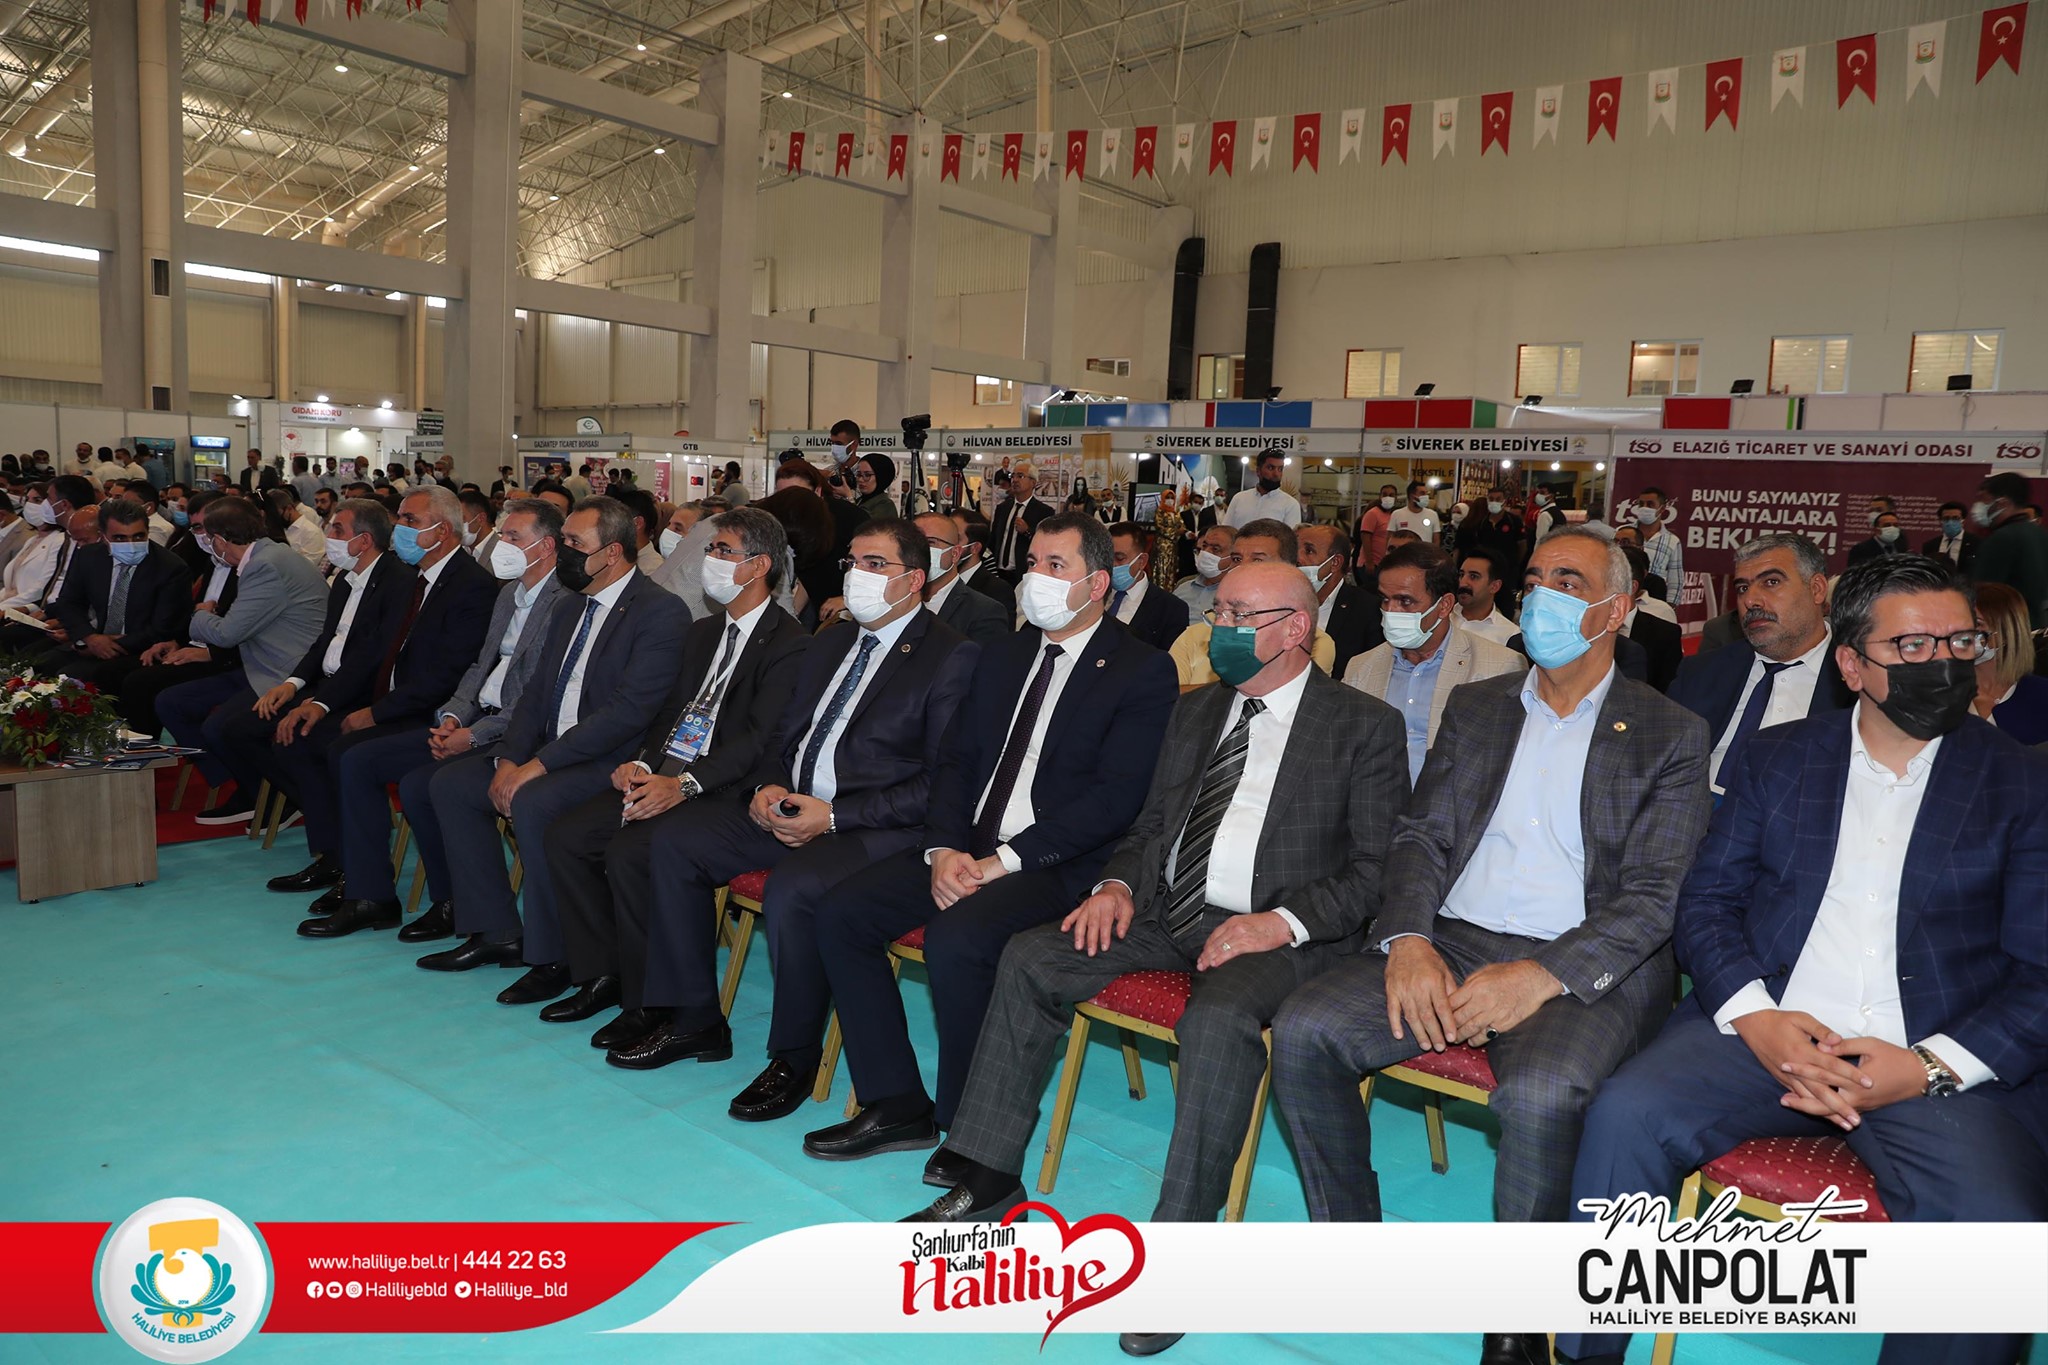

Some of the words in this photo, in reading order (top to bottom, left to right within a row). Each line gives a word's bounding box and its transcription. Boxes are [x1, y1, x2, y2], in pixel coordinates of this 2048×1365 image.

[578, 440, 600, 448] BORSASI
[683, 443, 699, 451] GTB
[806, 436, 832, 447] HİLVA
[963, 435, 1002, 447] HİLVAN
[1005, 434, 1072, 447] BELEDİYESİ
[1156, 434, 1211, 447] SİVEREK
[1215, 435, 1294, 449] BELEDİYESİ
[1396, 436, 1465, 451] SİVEREK
[1469, 436, 1569, 452] BELEDİYESİ
[1629, 440, 1662, 454] tso
[1673, 440, 1730, 453] ELAZIĞ
[1736, 440, 1807, 455] TİCARET
[1813, 444, 1836, 456] VE
[1841, 442, 1908, 456] SANAYİ
[1914, 444, 1973, 457] ODASI
[1996, 443, 2041, 459] tso
[1691, 489, 1742, 503] BUNU
[1747, 490, 1840, 506] SAYMAYIZ
[1690, 507, 1838, 527] AVANTAJLARA
